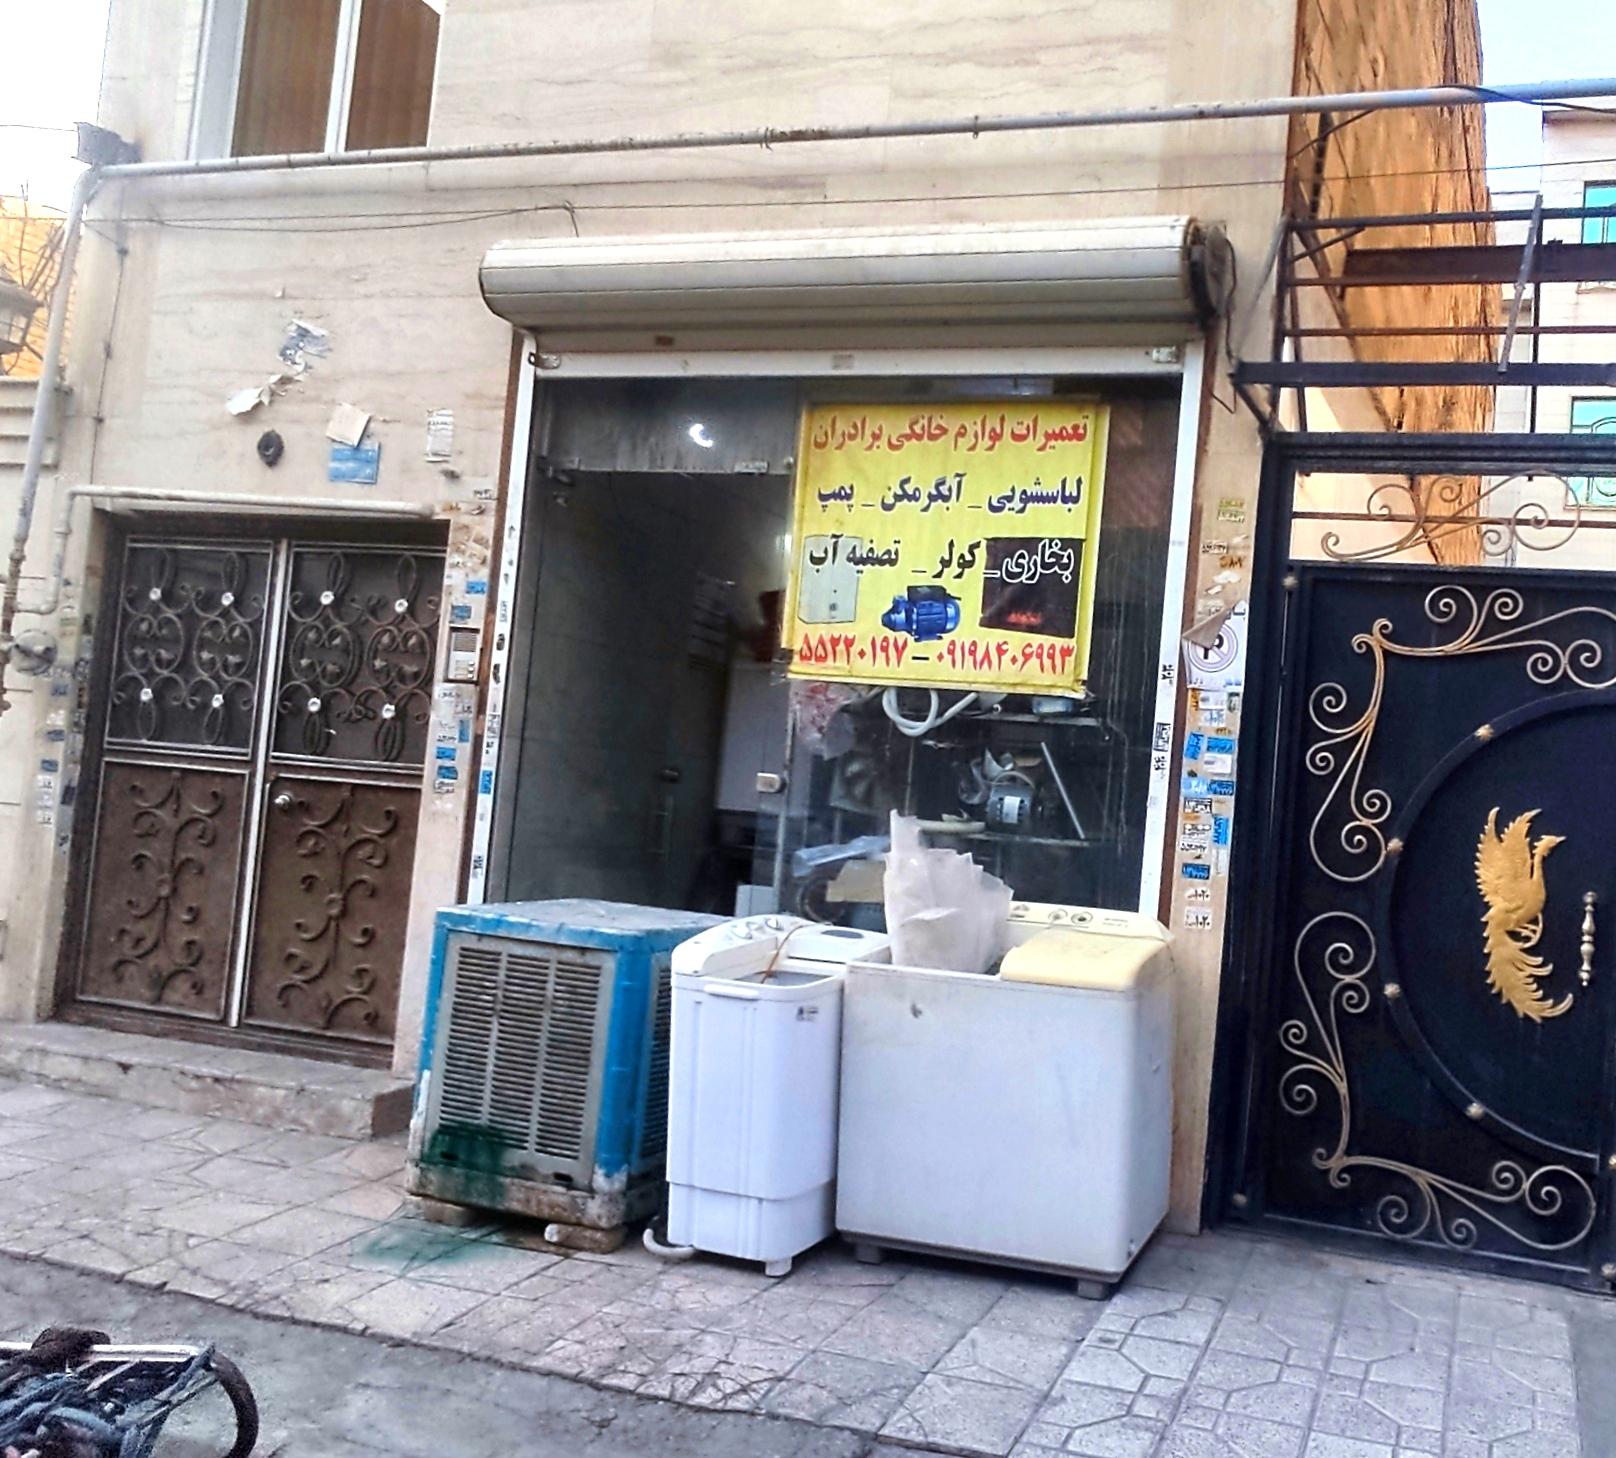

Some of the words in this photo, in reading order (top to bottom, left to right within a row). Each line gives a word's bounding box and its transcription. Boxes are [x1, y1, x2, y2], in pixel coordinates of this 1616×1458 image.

[813, 414, 882, 450] برادران
[887, 412, 948, 451] خانگی
[954, 414, 1005, 451] لوازم
[1010, 414, 1089, 452] تعمیرات
[817, 481, 854, 513] پمپ
[881, 472, 967, 512] آبگرمکن
[987, 475, 1083, 514] لباسشویی
[809, 533, 844, 573] آب
[846, 536, 901, 574] تصفیه
[931, 538, 981, 579] کولر
[1002, 539, 1075, 584] بخاری
[799, 632, 908, 668] ۵۵۲۲۰۱۹۷
[937, 639, 1075, 675] ۰۹۱۹۸۴۰۶۹۹۳
